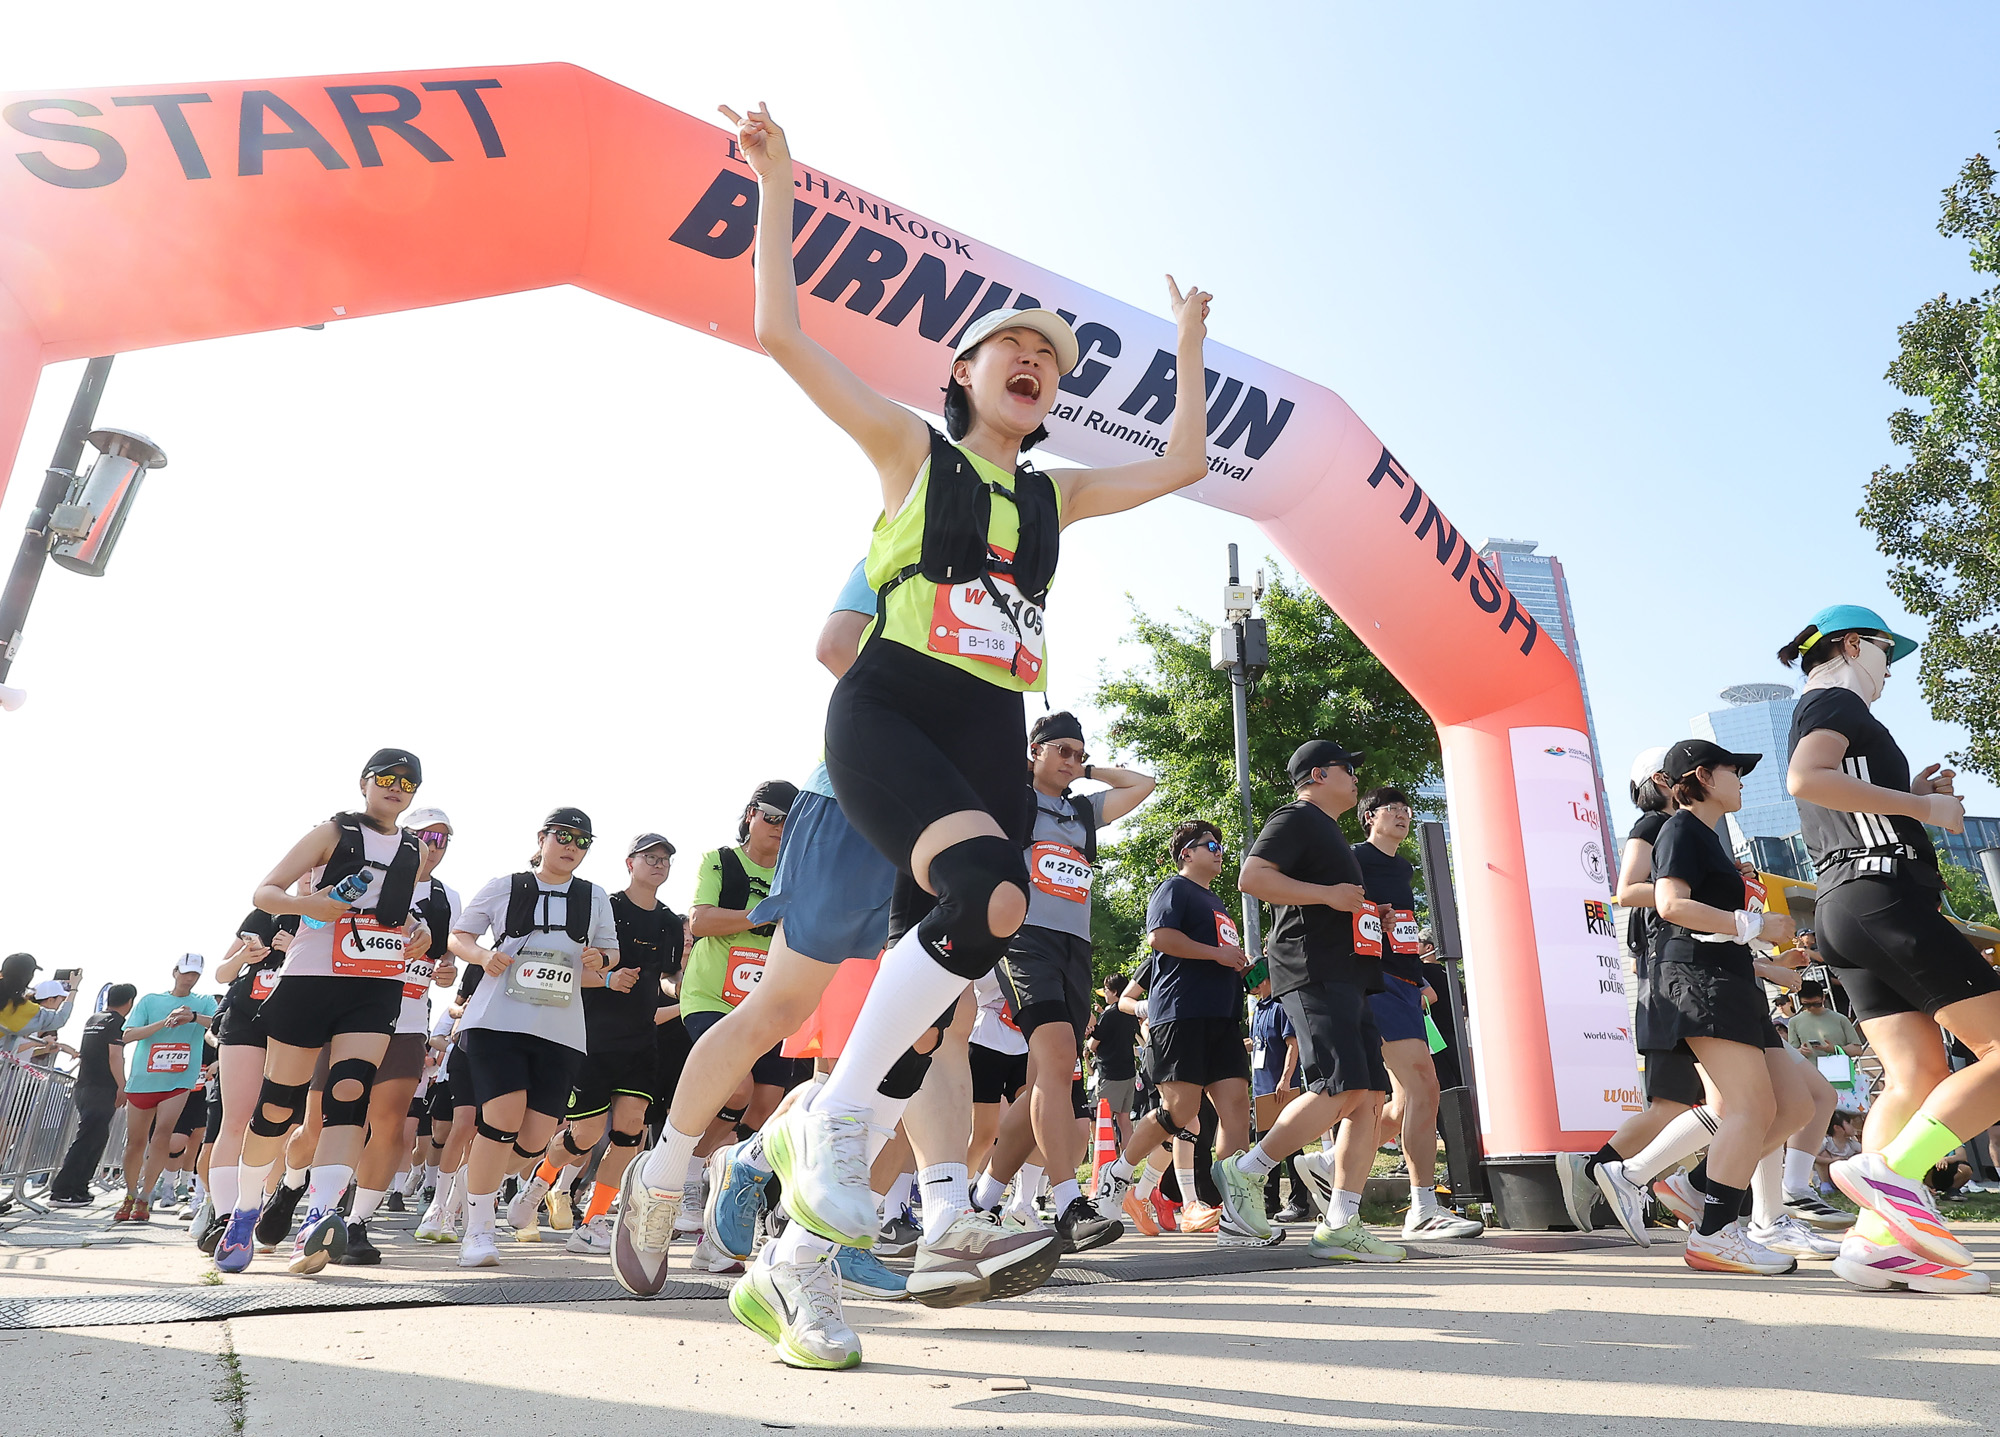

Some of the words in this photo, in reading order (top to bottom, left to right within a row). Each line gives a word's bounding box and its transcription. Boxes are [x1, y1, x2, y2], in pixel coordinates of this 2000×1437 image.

[2, 78, 507, 189] START
[668, 168, 1122, 399] BURNIG
[1118, 348, 1295, 461] RUN
[1083, 410, 1169, 458] Running
[1367, 445, 1538, 657] FINISH
[965, 587, 988, 605] W
[968, 636, 1006, 651] B-136
[1045, 861, 1055, 869] M
[1057, 862, 1091, 879] 2767
[1058, 876, 1074, 885] A-20
[1364, 917, 1371, 930] M
[1587, 918, 1617, 939] KIND
[366, 936, 402, 951] 4666
[1596, 954, 1620, 970] TOUS
[523, 968, 534, 978] W
[536, 967, 572, 984] 5810
[740, 970, 751, 980] W
[1599, 979, 1625, 995] JOURS
[1583, 1031, 1607, 1040] World
[1607, 1032, 1625, 1041] Vision
